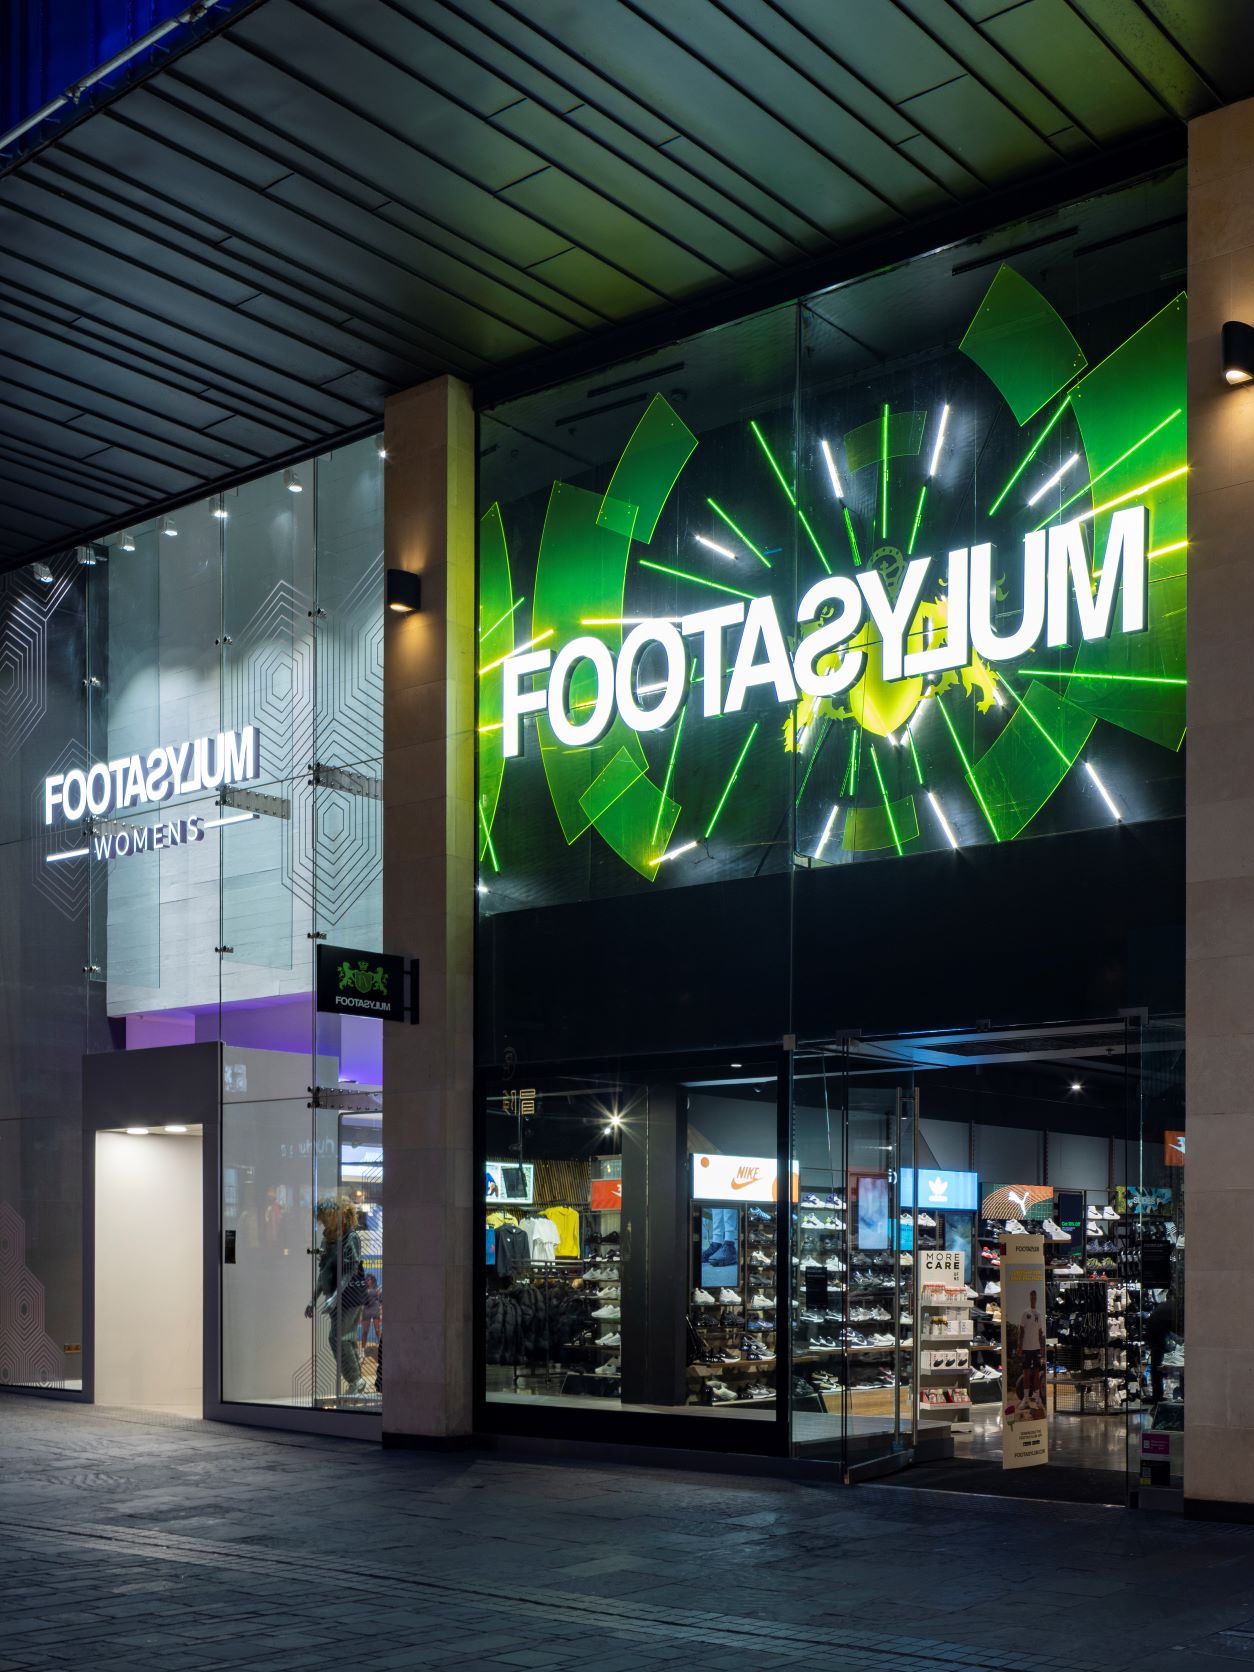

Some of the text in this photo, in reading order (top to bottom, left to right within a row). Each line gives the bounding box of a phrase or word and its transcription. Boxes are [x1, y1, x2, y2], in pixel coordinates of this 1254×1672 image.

[501, 505, 1150, 759] FOOTASYLUM
[45, 724, 257, 826] FOOTASYLUM
[94, 815, 203, 861] WOMENS
[335, 995, 391, 1012] FOOTASYLUM
[736, 1166, 760, 1180] NIKE
[926, 1252, 960, 1262] MORE
[926, 1262, 960, 1270] CARE
